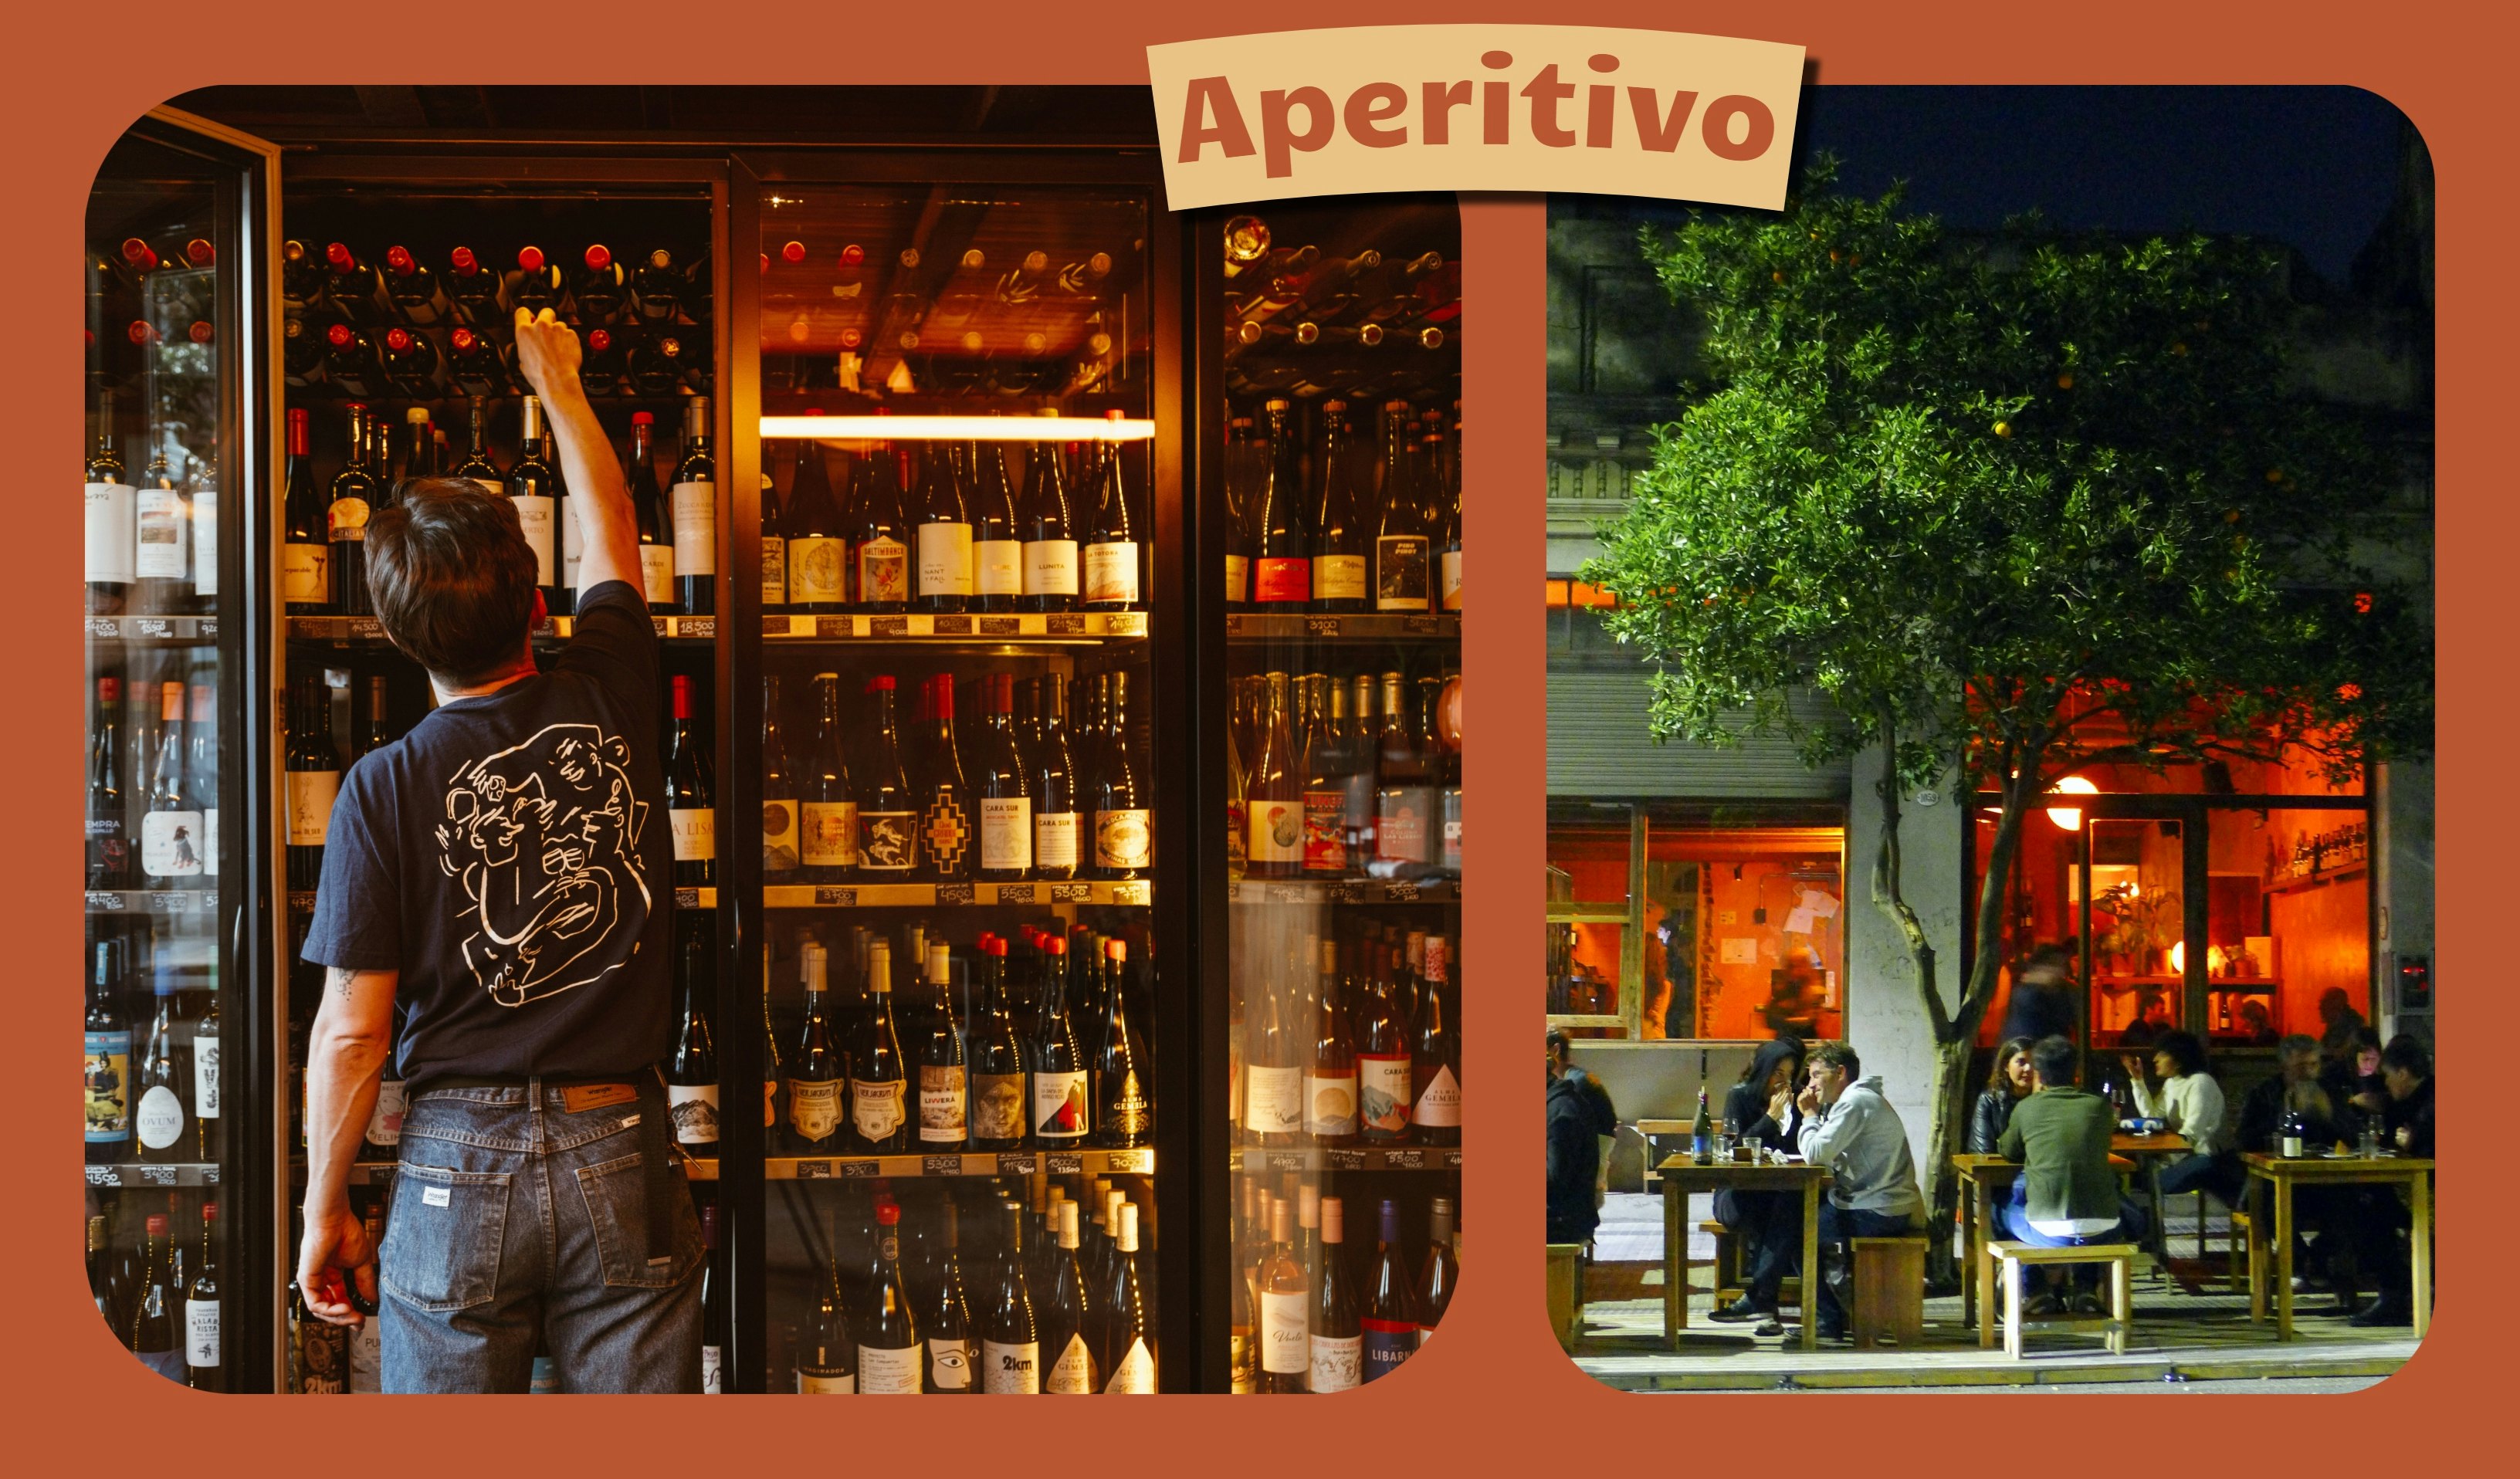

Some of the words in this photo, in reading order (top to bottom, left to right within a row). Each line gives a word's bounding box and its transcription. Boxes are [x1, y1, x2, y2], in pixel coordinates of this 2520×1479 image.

[940, 889, 971, 902] 4500
[1001, 889, 1032, 899] 5500
[1055, 888, 1086, 898] 5500
[142, 1118, 176, 1126] OVUM
[1002, 1355, 1032, 1371] 2km
[304, 1377, 343, 1395] 2km
